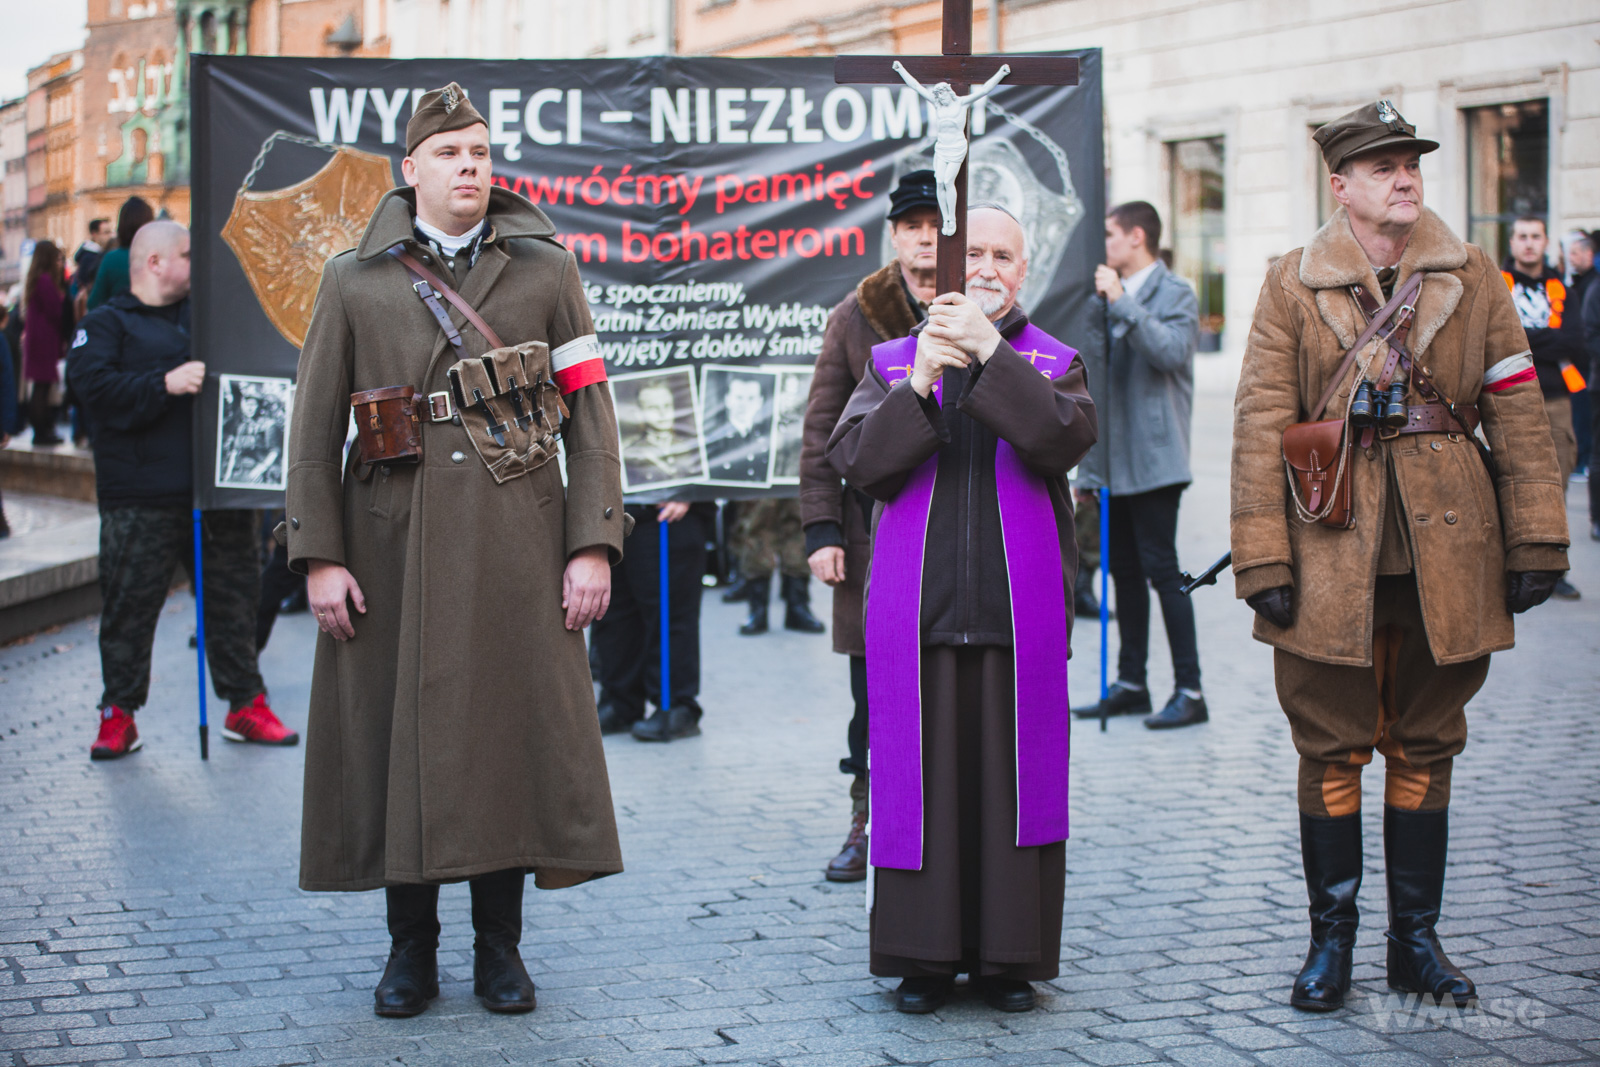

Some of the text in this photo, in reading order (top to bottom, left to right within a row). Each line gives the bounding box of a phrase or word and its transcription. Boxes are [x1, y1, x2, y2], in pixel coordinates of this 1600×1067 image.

[309, 87, 582, 162] WYĘCI
[714, 160, 875, 214] pamięć
[621, 220, 865, 263] bohaterom
[605, 279, 746, 309] spoczniemy,
[674, 340, 690, 359] z
[766, 331, 824, 357] śmie
